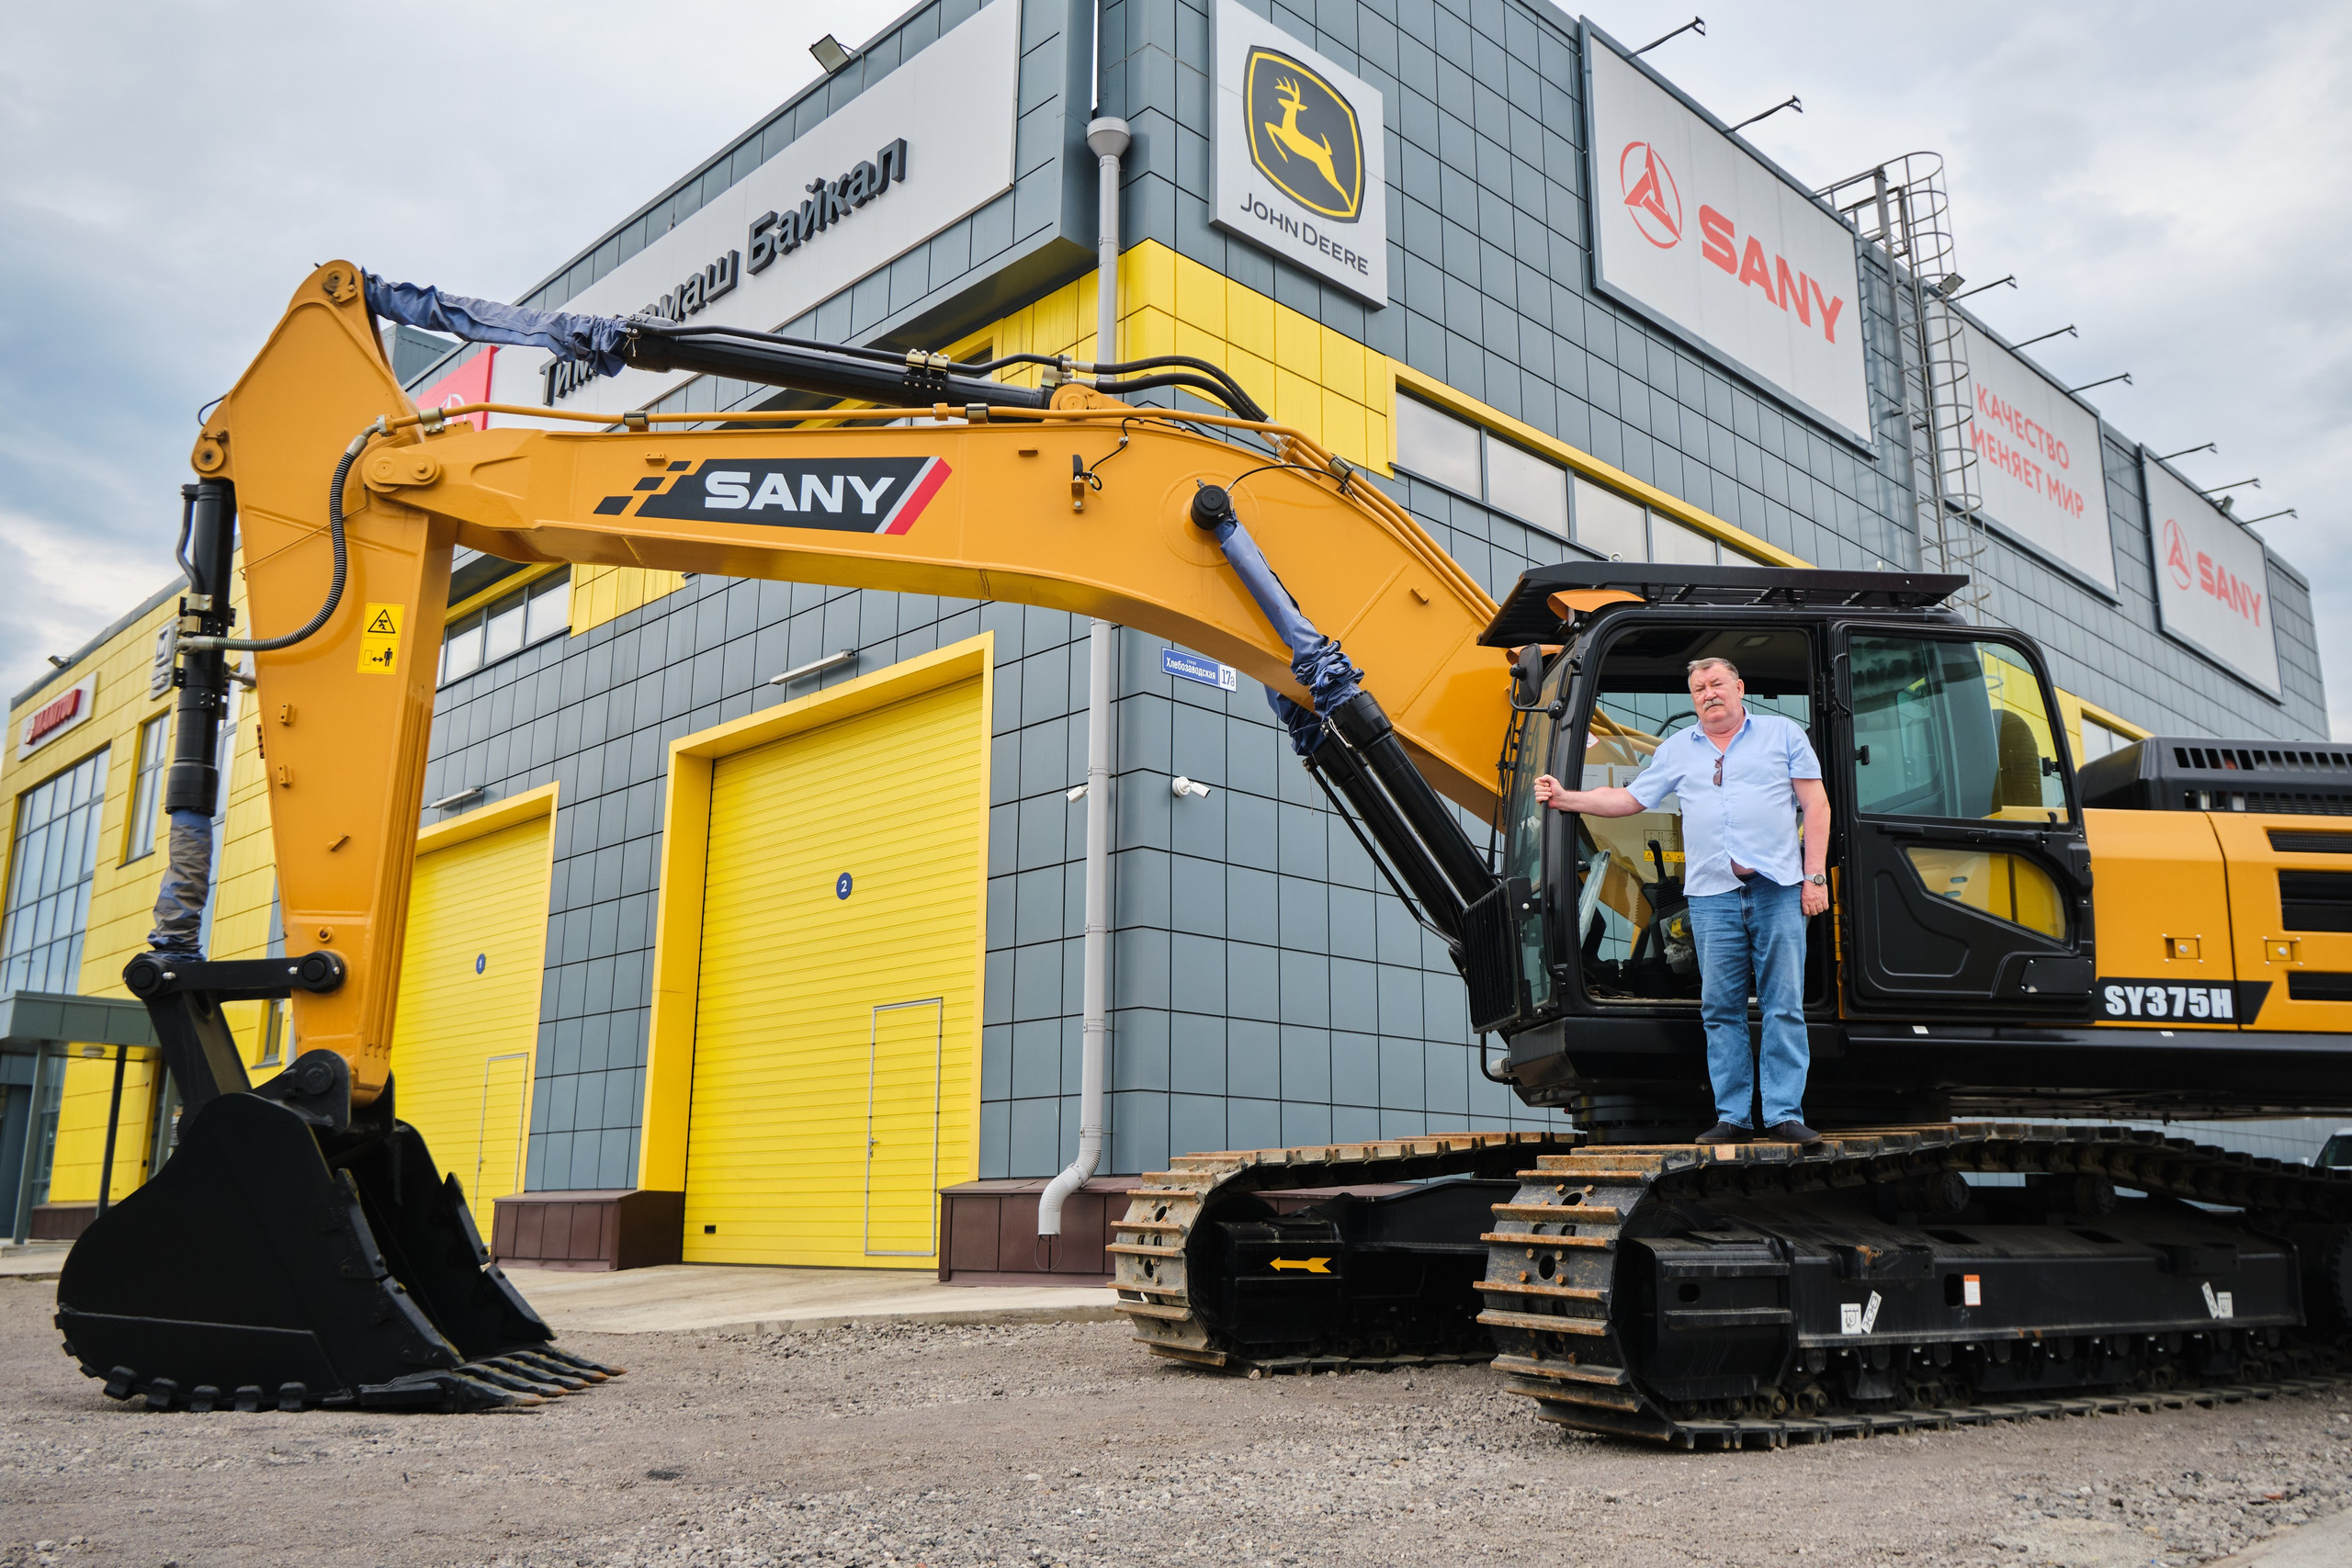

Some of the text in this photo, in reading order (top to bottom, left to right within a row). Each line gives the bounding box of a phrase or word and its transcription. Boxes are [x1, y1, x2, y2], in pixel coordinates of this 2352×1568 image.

[539, 137, 908, 407] Тиммаш Байкал
[1240, 192, 1369, 276] JOHN DEERE
[1698, 204, 1844, 345] SANY
[1976, 381, 2070, 470] КАЧЕСТВО
[704, 470, 897, 514] SANY
[1969, 421, 2085, 520] МЕНЯЕТ МИР
[2196, 550, 2262, 628] SANY
[1166, 657, 1235, 687] Хлебозаводская 17а
[841, 879, 848, 893] 2
[479, 958, 483, 969] 1
[2104, 985, 2233, 1019] SY375H
